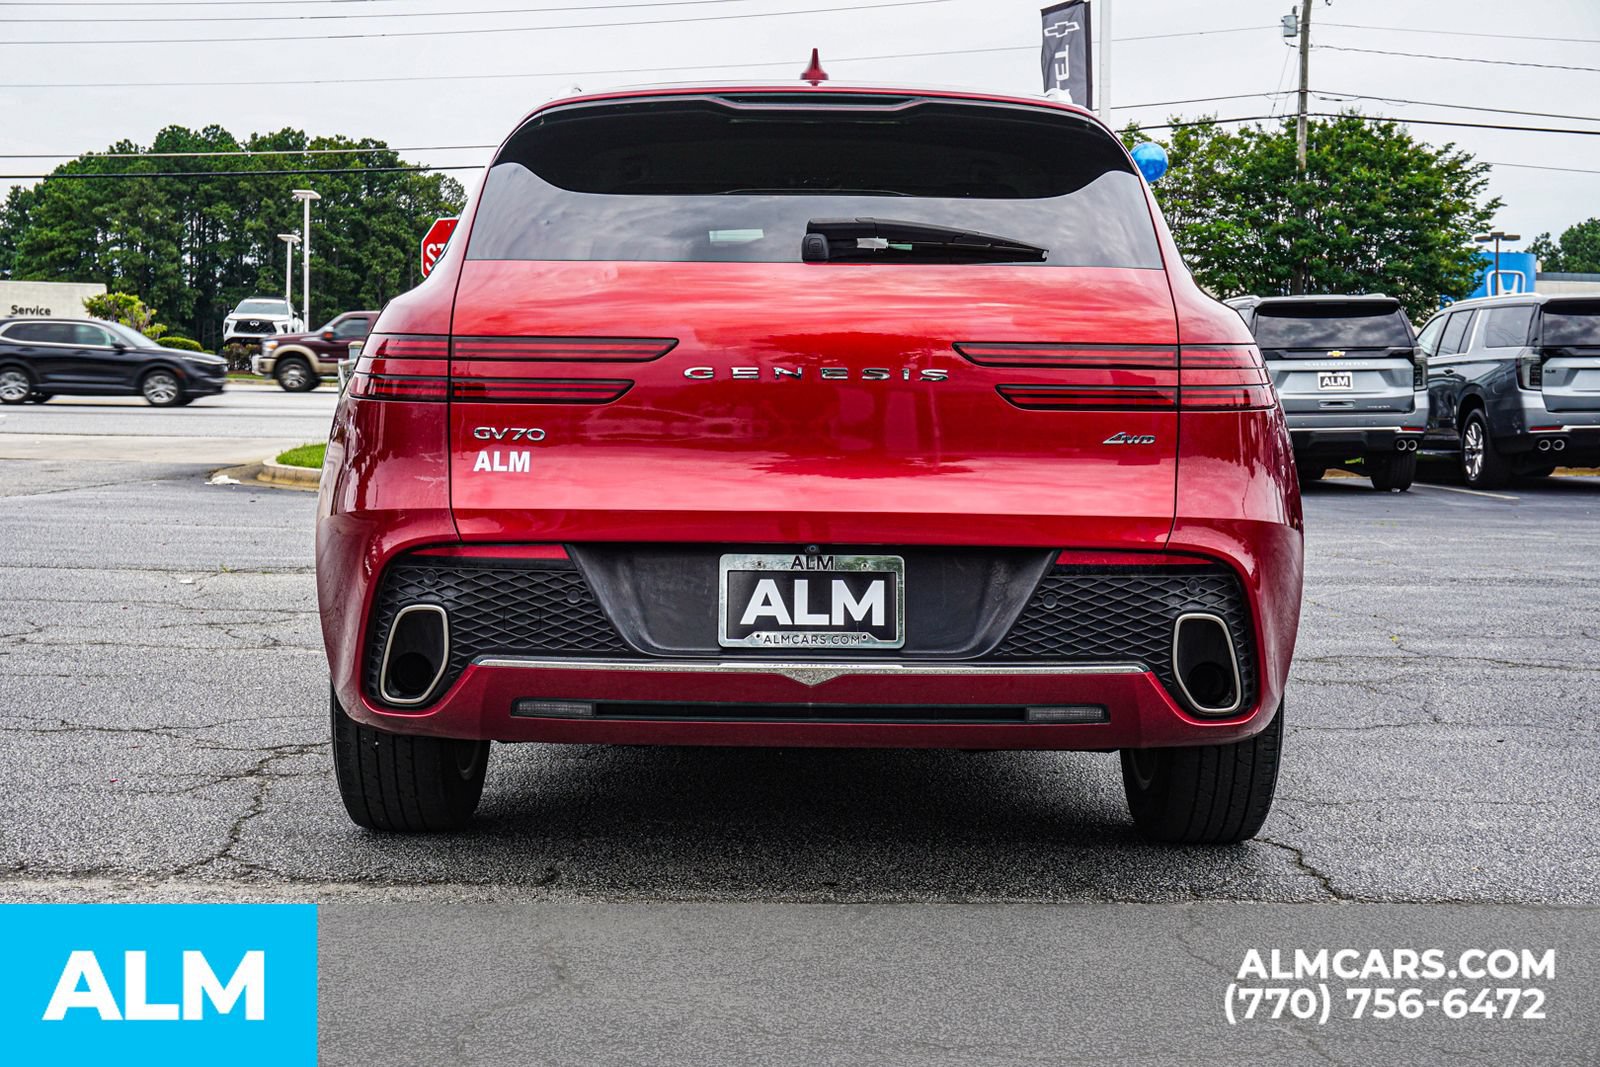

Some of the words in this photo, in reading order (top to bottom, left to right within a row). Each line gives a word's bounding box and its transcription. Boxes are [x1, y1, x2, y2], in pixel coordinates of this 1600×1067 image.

[11, 304, 51, 316] Service
[683, 366, 949, 382] GENESIS
[1322, 377, 1349, 387] ALM
[473, 426, 546, 441] GV70
[1102, 431, 1156, 444] 4WD
[473, 450, 531, 473] ALM
[791, 555, 834, 571] ALM
[739, 578, 885, 627] ALM
[763, 635, 861, 645] ALMCARS.COM
